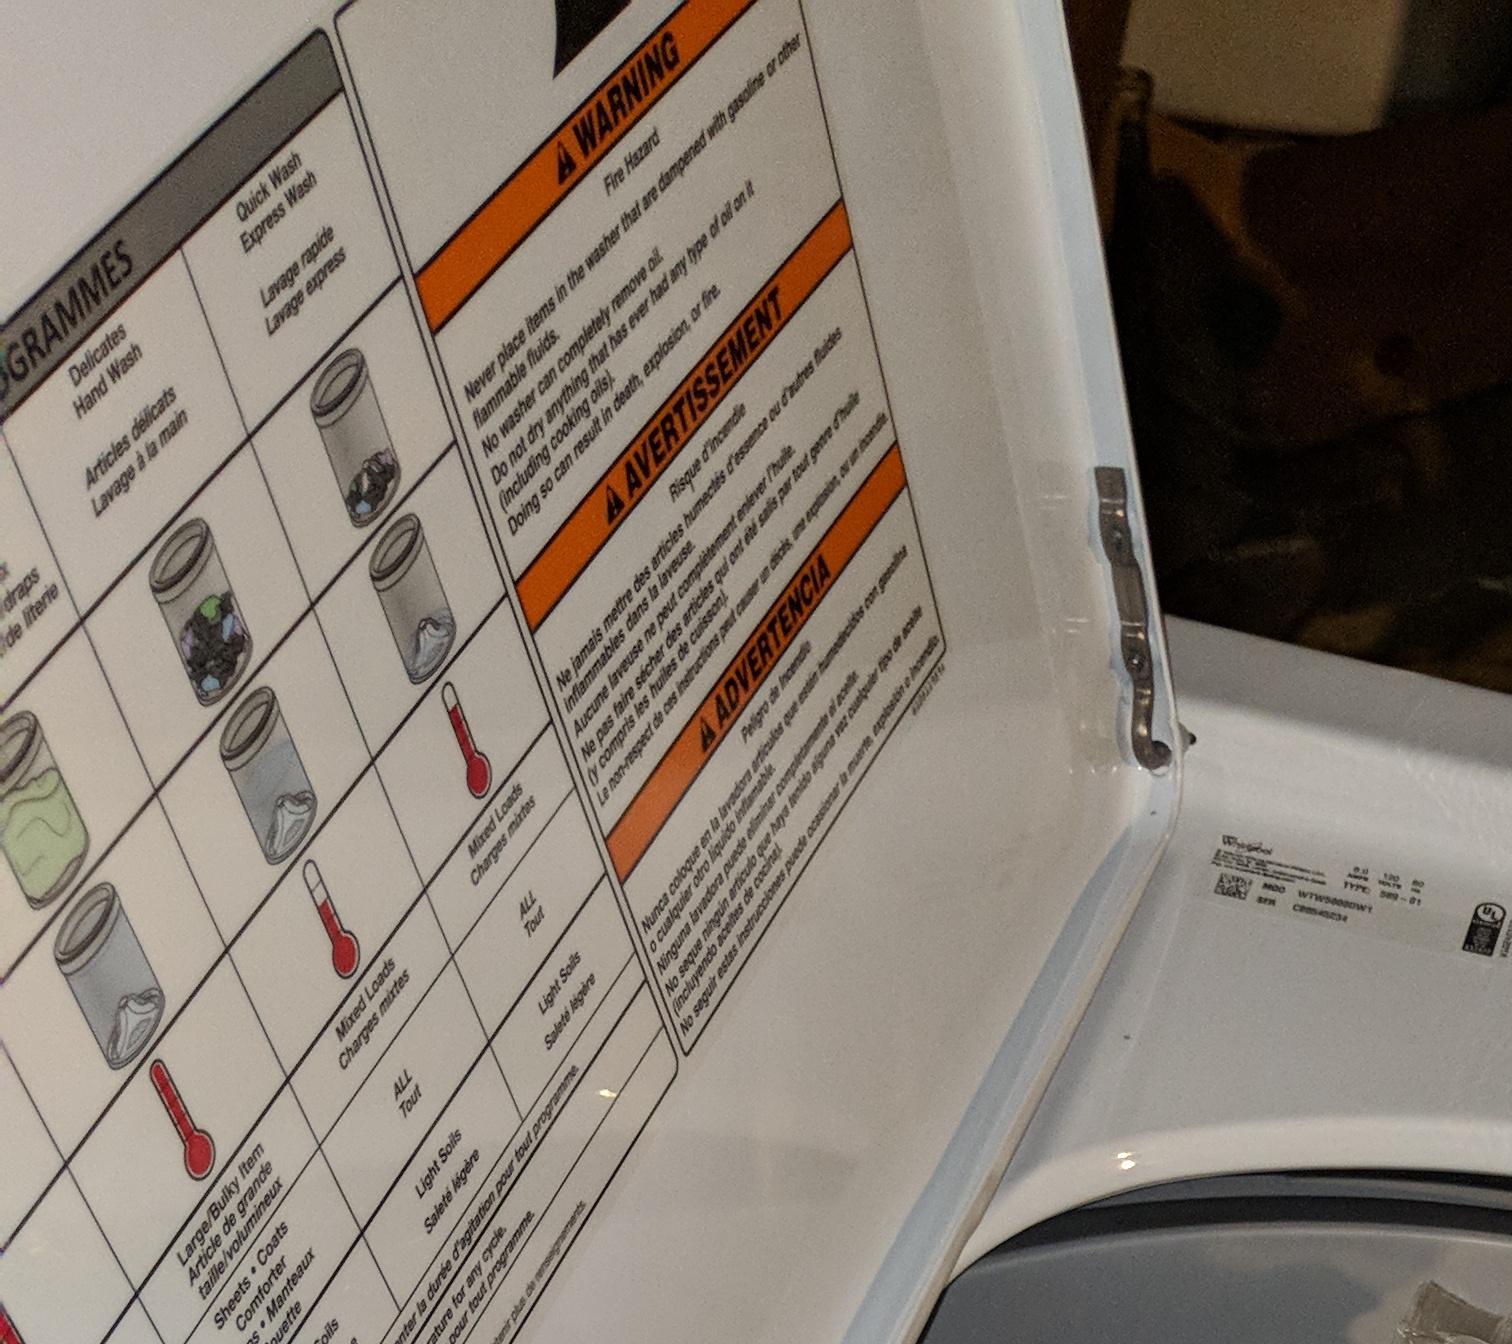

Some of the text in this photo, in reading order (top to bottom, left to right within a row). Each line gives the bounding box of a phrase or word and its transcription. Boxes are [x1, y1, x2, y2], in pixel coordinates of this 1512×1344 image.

[571, 30, 681, 159] WARNING
[235, 151, 302, 223] Quick Wash
[602, 126, 661, 197] Fire Hazard
[238, 170, 318, 254] Express Wash
[259, 225, 334, 309] Lavage rapide
[264, 246, 347, 337] Lavage express
[67, 323, 127, 388] Delicates
[72, 342, 143, 420] Hand Wash
[480, 246, 664, 459] No washer can completely remove oil.
[623, 284, 782, 500] AVERTISSEMENT
[85, 386, 177, 491] Articles délicats
[90, 408, 189, 518] Lavage à la main
[498, 368, 616, 515] (including cooking oils).
[668, 402, 746, 503] Risque d'incendie
[714, 553, 831, 729] ADVERTENCIA
[740, 639, 812, 744] Peligro de Incendio
[334, 957, 396, 1043] Mixed Loads
[338, 968, 410, 1071] Charges mixtes
[393, 1068, 413, 1101] ALL
[398, 1082, 422, 1119] Tout
[176, 1142, 265, 1267] Large/Bulky Item
[414, 1128, 462, 1200] Light Soils
[423, 1148, 480, 1235] Saleté légère
[188, 1160, 273, 1287] Article de grande
[197, 1176, 283, 1301] taille/volumineux
[213, 1221, 289, 1330] Sheets Coats
[235, 1254, 287, 1332] Comforter
[265, 1247, 315, 1323] Manteaux
